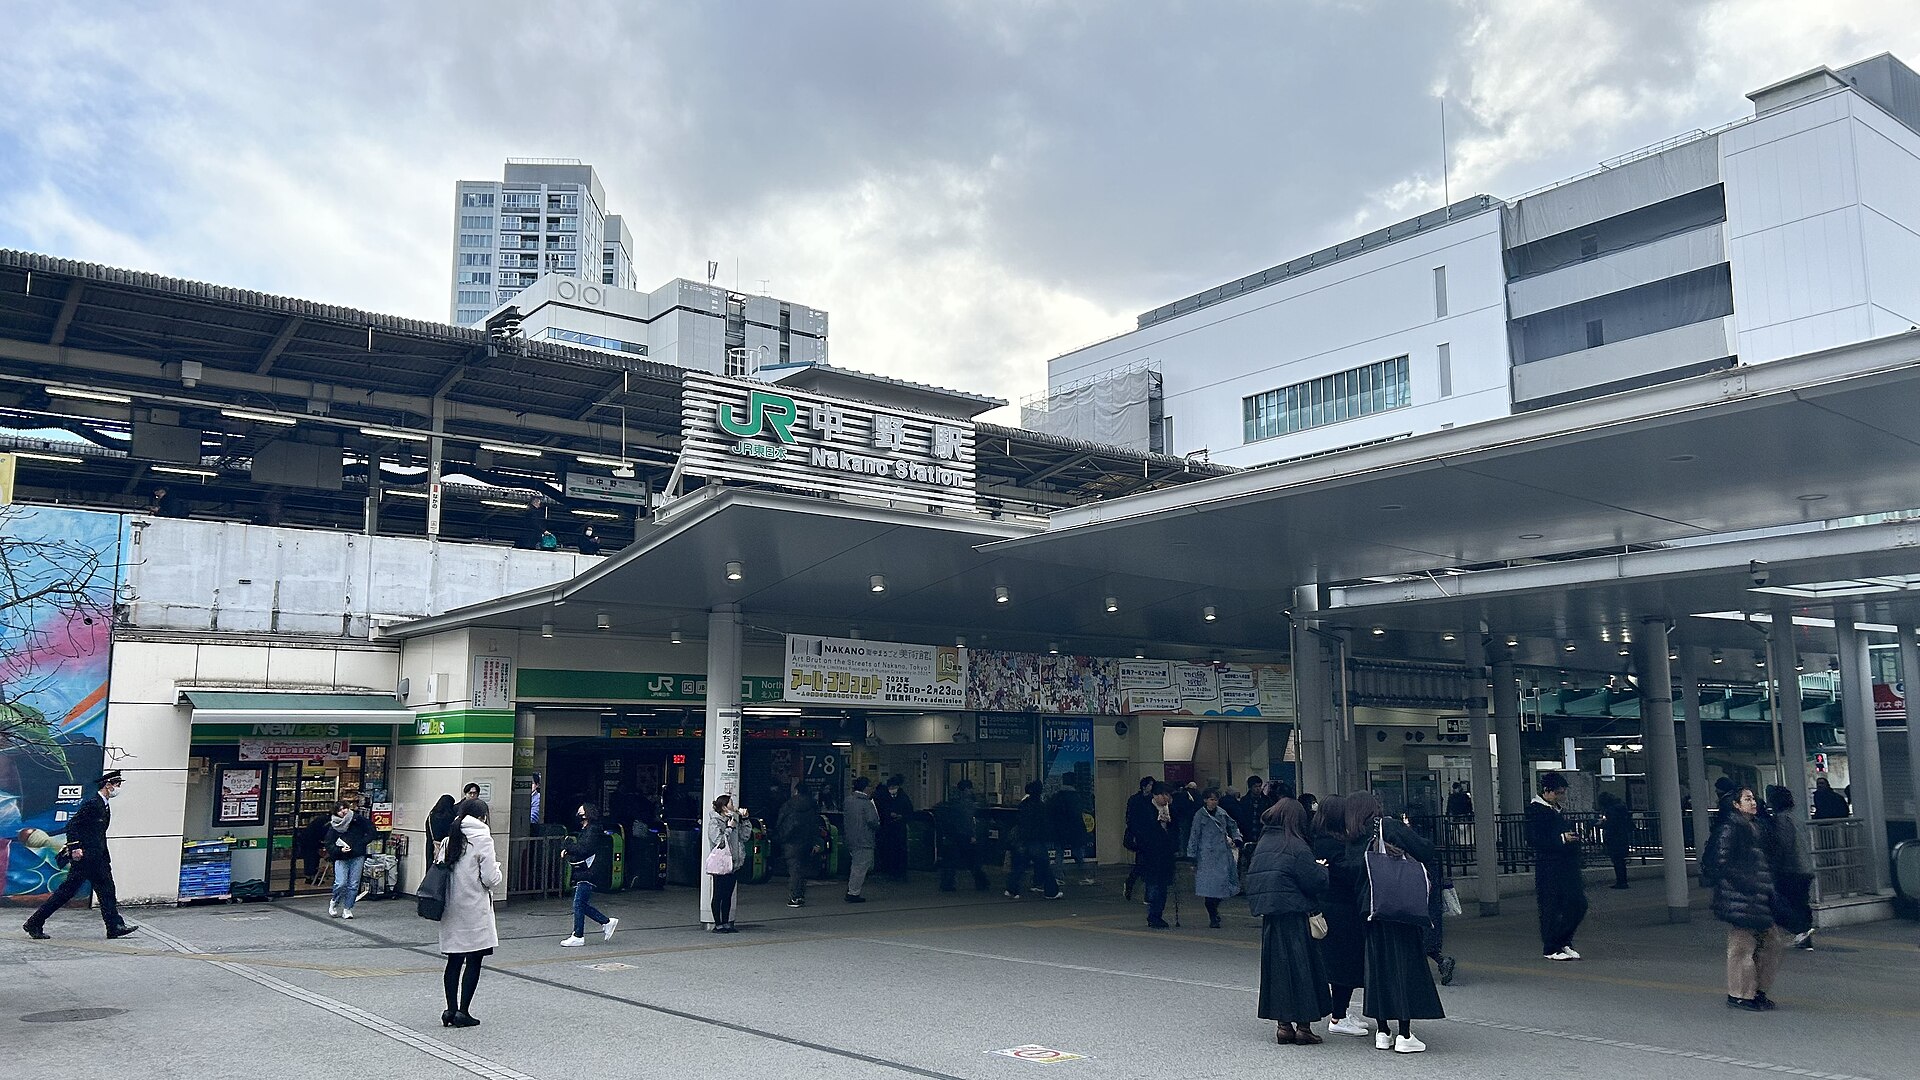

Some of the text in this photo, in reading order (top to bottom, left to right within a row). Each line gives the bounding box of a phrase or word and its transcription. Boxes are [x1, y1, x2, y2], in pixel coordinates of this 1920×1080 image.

[718, 391, 798, 446] JR
[810, 404, 964, 461] 中野駅
[732, 441, 789, 461] JR東日本
[810, 447, 964, 486] Nakano Station
[824, 645, 865, 655] NAKANO
[648, 676, 674, 693] JR
[416, 719, 445, 735] NewDays
[1046, 728, 1090, 743] 中野駅前
[722, 728, 731, 750] あちら
[1046, 744, 1091, 752] タワーマンション
